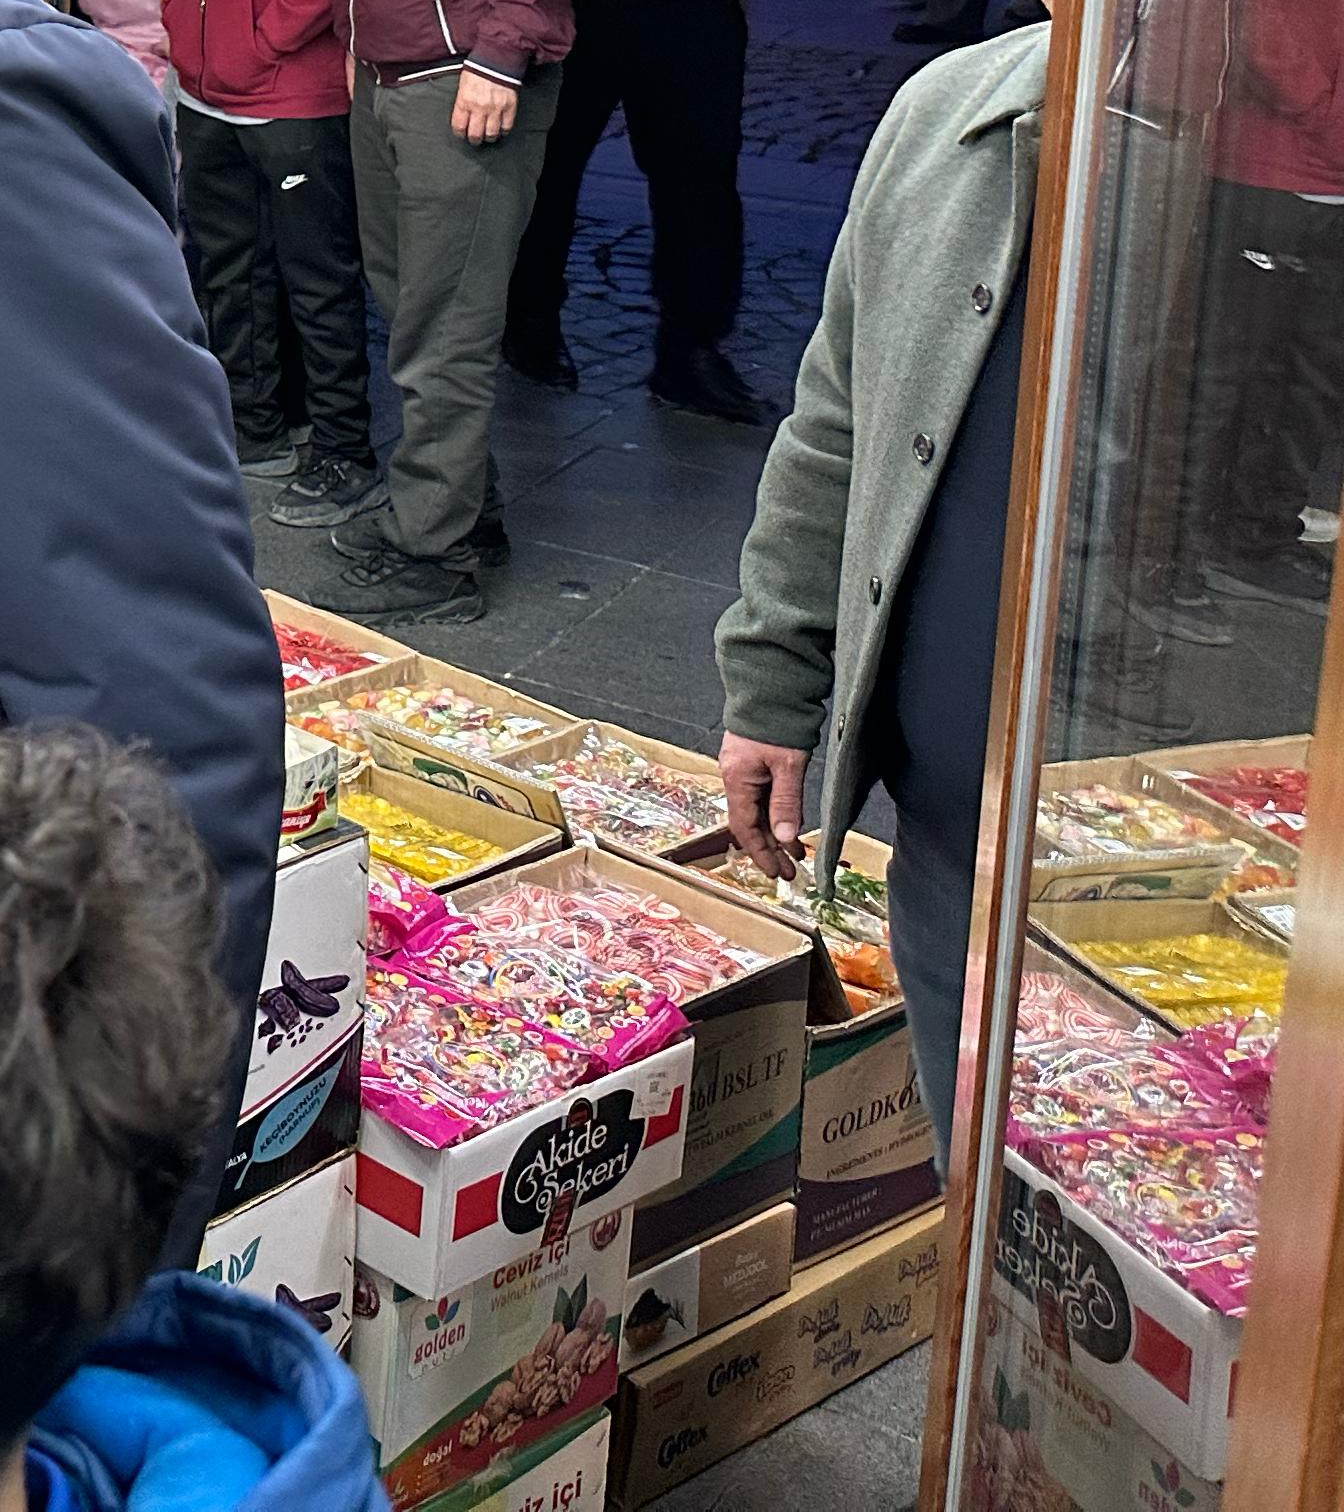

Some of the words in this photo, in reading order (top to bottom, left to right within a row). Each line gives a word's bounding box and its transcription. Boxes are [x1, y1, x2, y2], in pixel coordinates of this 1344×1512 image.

[763, 1049, 788, 1082] TF
[520, 1119, 608, 1192] Akide
[537, 1142, 629, 1207] Şekeri
[492, 1250, 543, 1289] Ceviz
[413, 1322, 466, 1366] golden
[423, 1440, 452, 1467] doğal
[552, 1470, 583, 1510] içi
